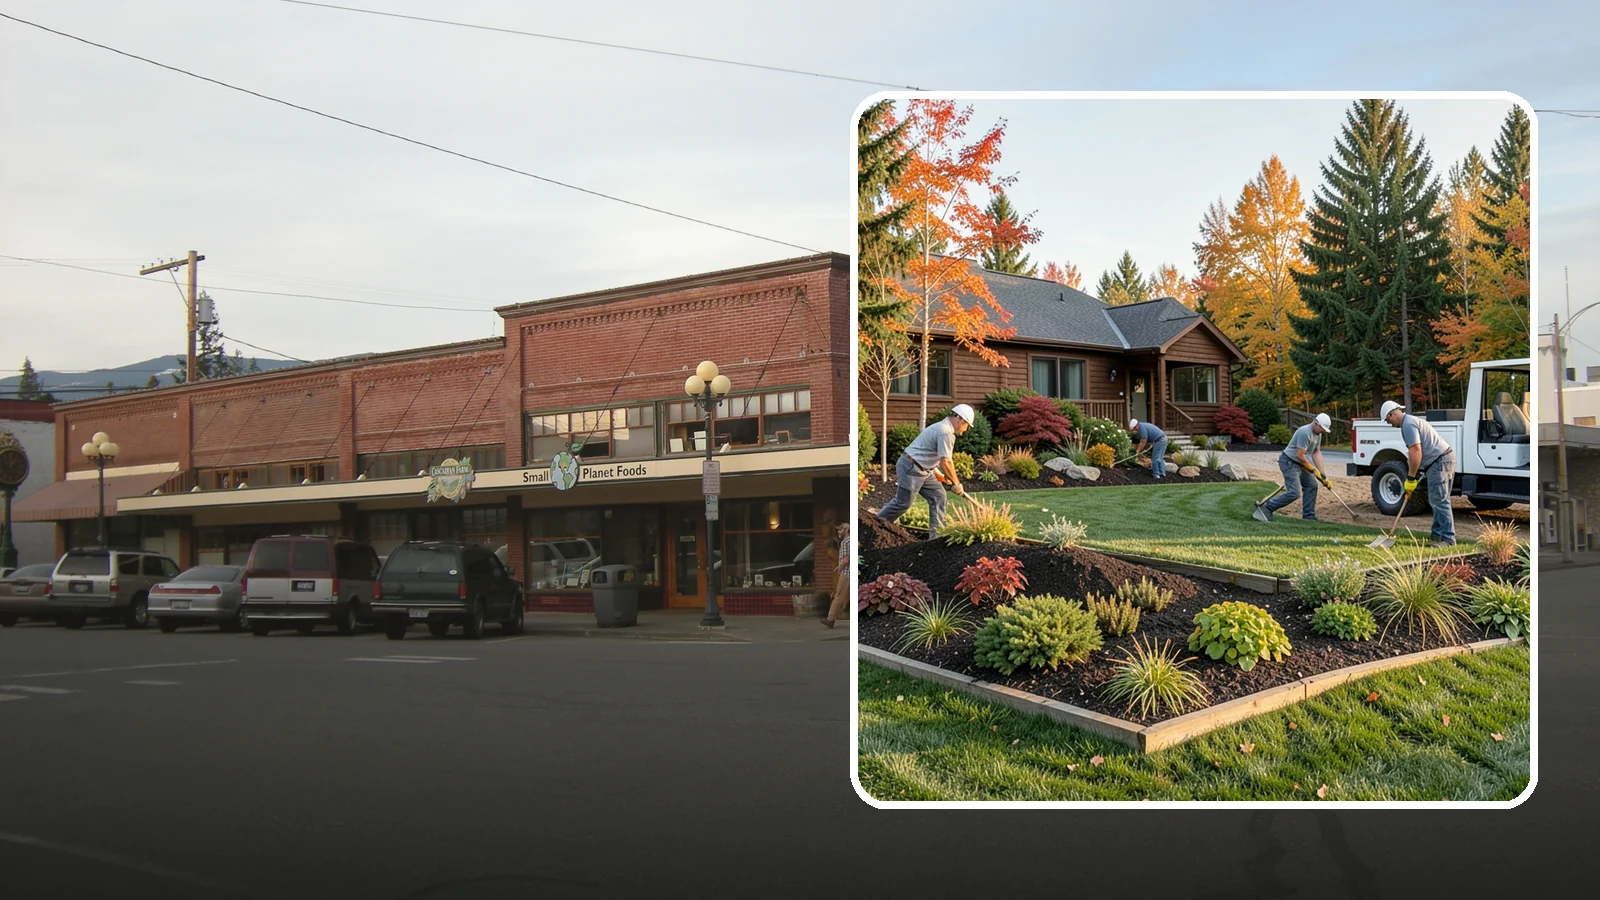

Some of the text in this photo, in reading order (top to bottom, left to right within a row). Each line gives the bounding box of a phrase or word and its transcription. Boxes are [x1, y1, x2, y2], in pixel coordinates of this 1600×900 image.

[523, 464, 647, 483] Small Planet Foods
